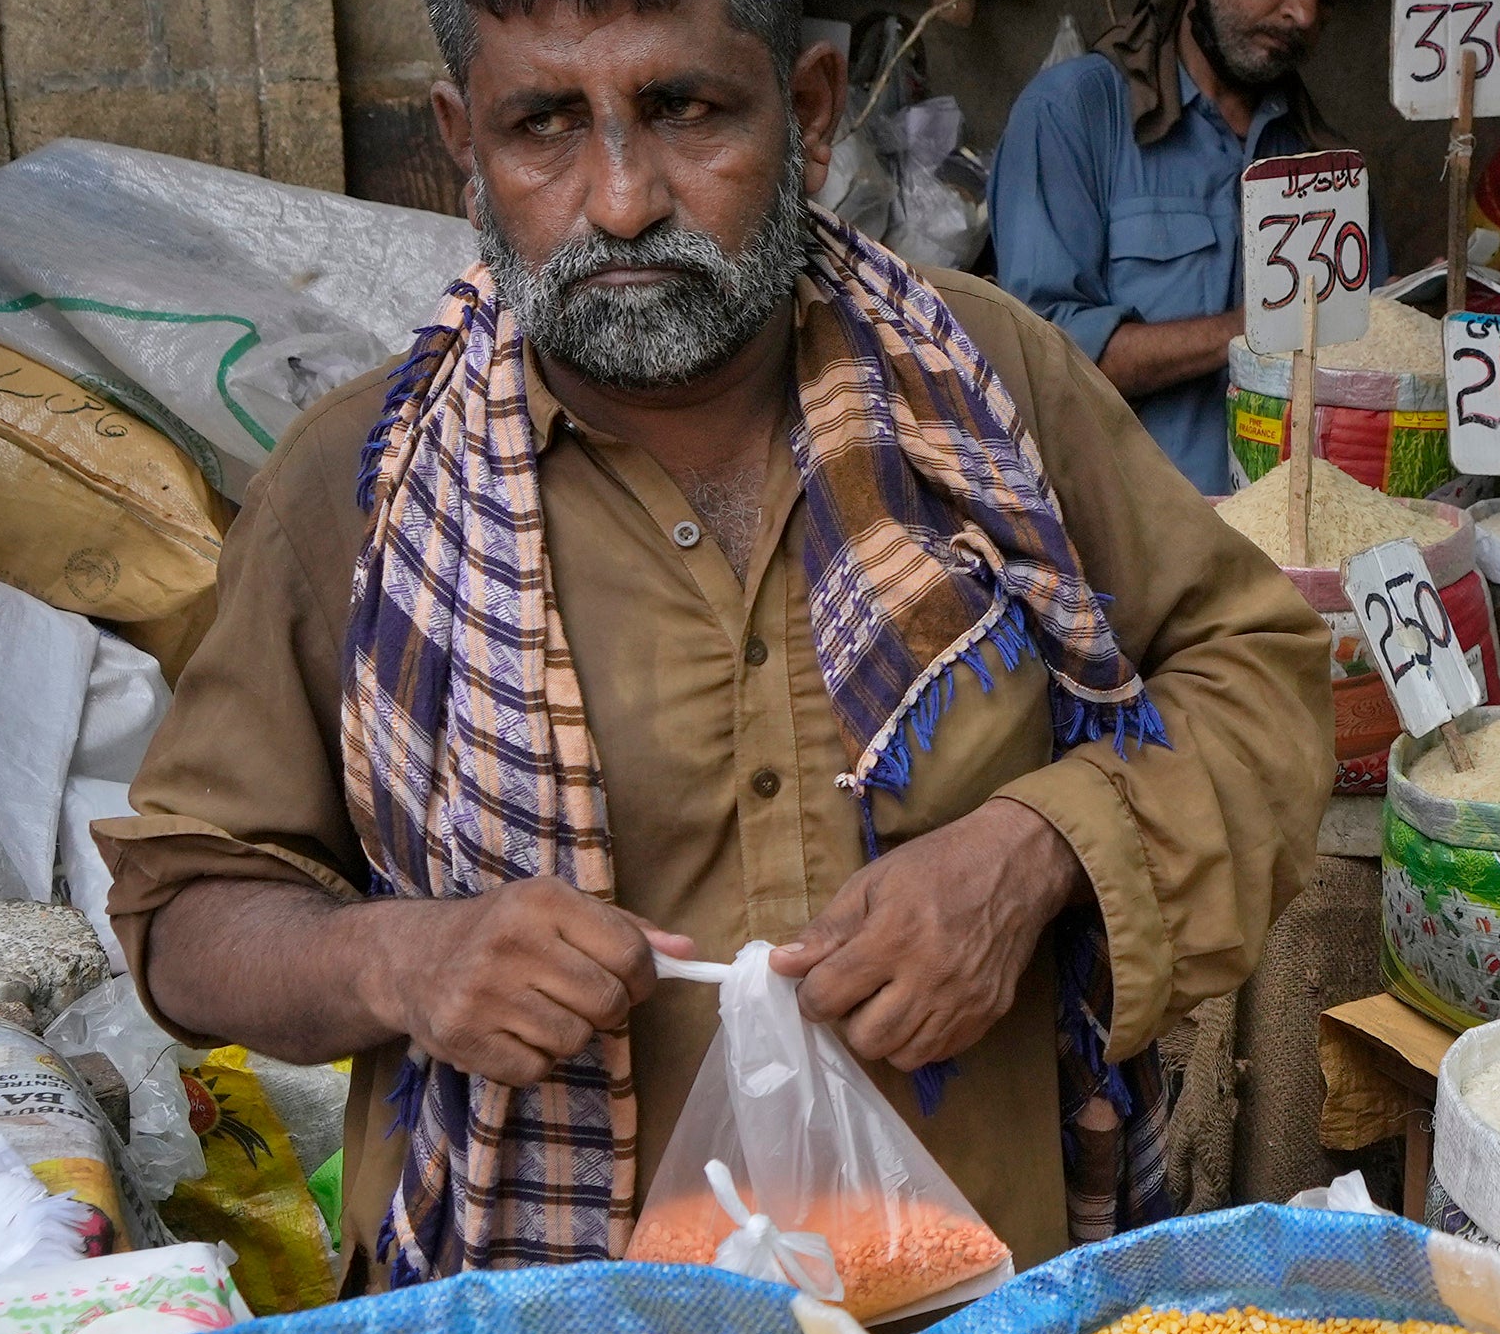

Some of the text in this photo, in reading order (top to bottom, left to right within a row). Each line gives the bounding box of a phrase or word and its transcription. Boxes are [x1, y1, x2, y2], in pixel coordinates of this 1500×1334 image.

[1259, 208, 1369, 311] 330
[1239, 423, 1277, 441] FRAGRANCE
[1249, 417, 1263, 427] FINE
[1364, 572, 1452, 688] 250
